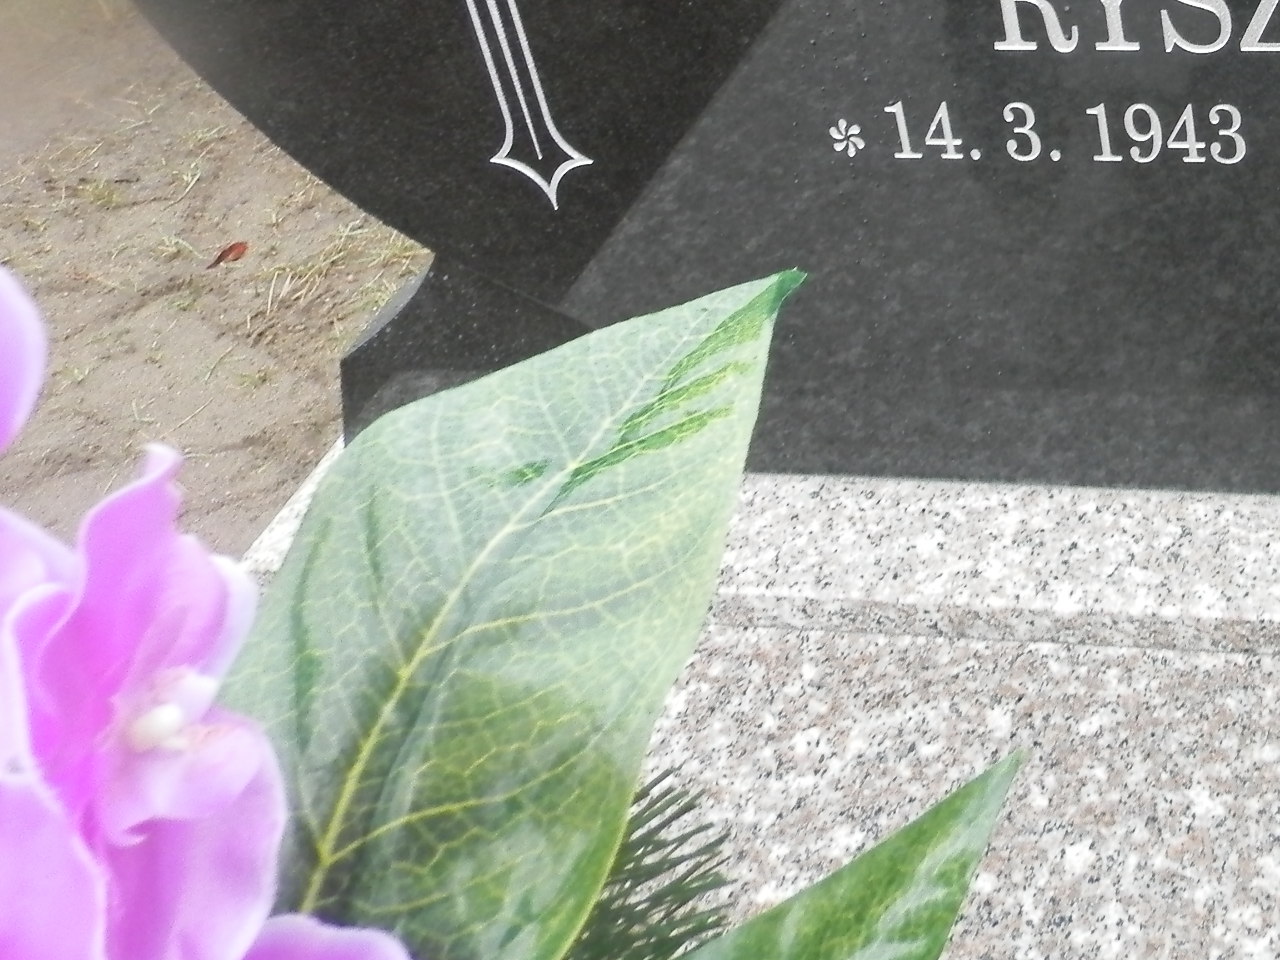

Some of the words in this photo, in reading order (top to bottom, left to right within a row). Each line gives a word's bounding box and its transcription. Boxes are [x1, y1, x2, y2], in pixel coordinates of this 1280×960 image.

[883, 100, 982, 161] 14.
[1002, 101, 1062, 162] 3.
[1085, 102, 1247, 165] 1943
